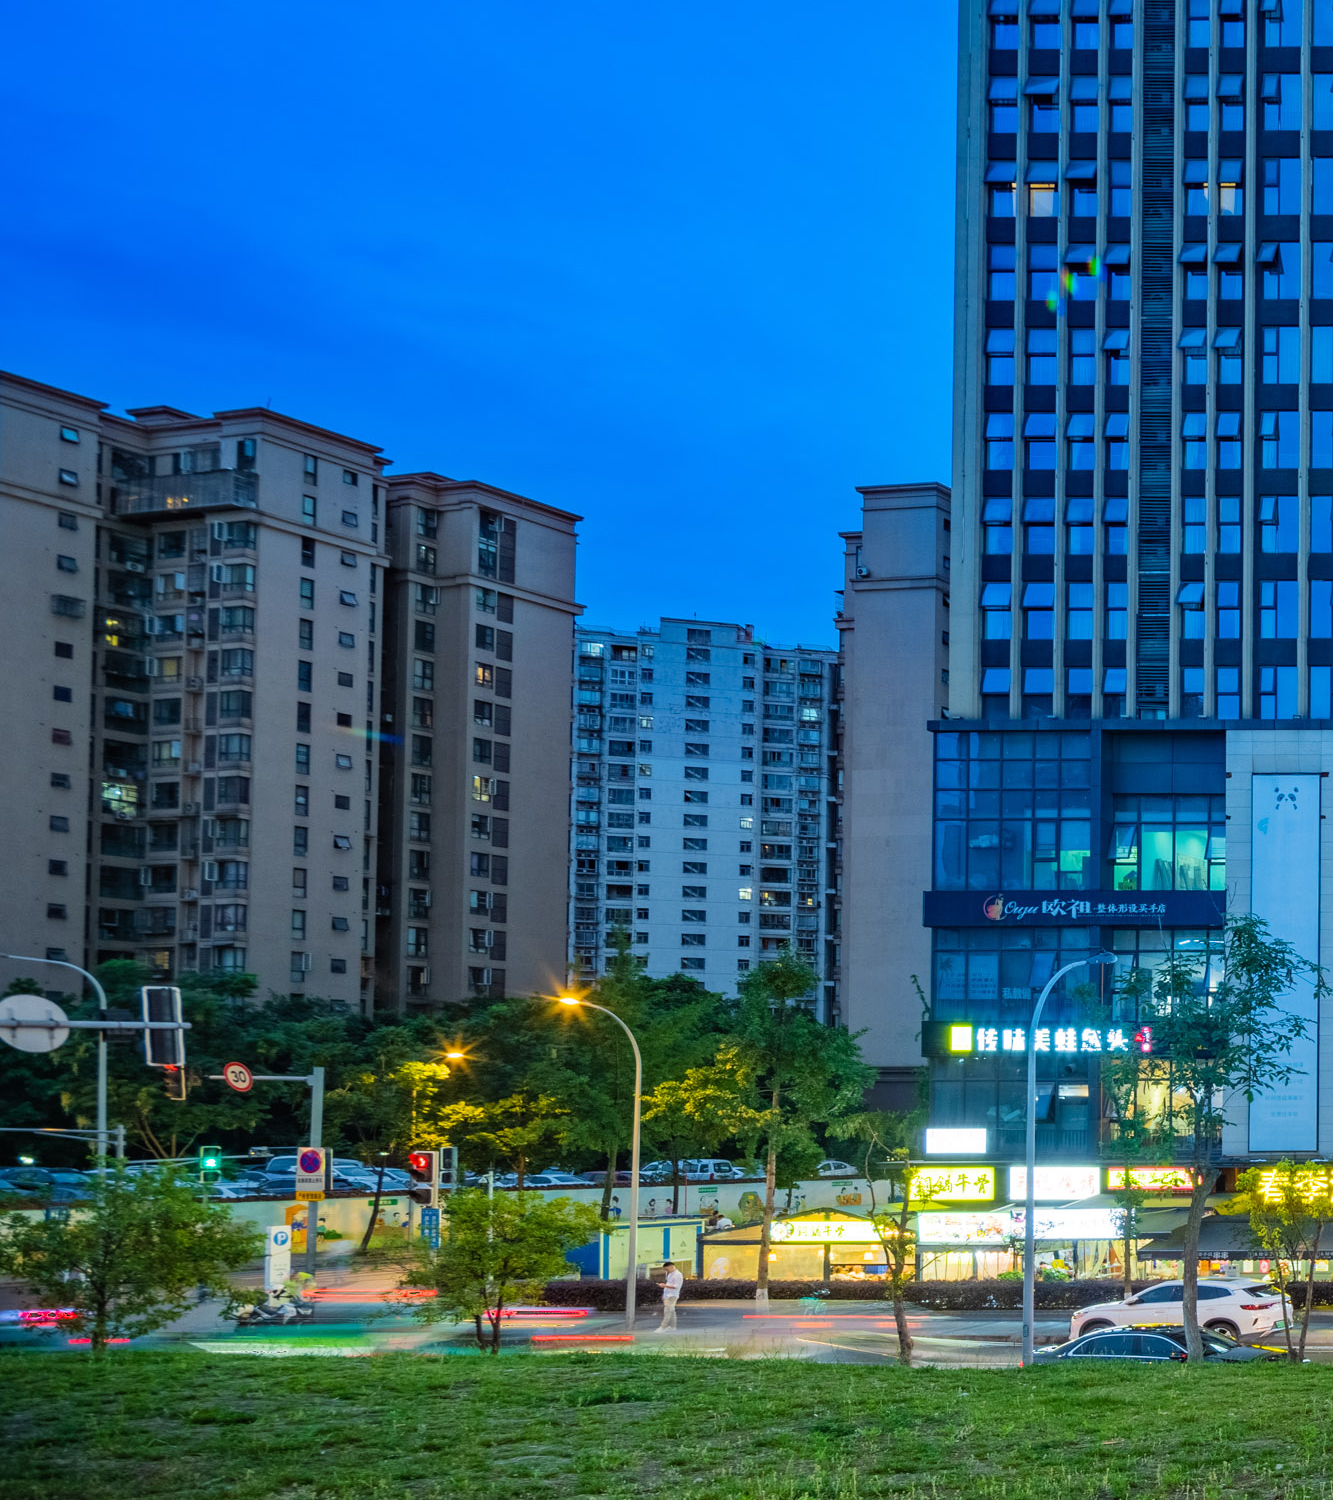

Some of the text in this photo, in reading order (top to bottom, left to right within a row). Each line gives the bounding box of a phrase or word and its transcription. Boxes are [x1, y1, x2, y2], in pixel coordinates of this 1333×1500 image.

[1042, 898, 1091, 919] 欧祖
[231, 1069, 247, 1083] 30
[277, 1233, 286, 1245] P
